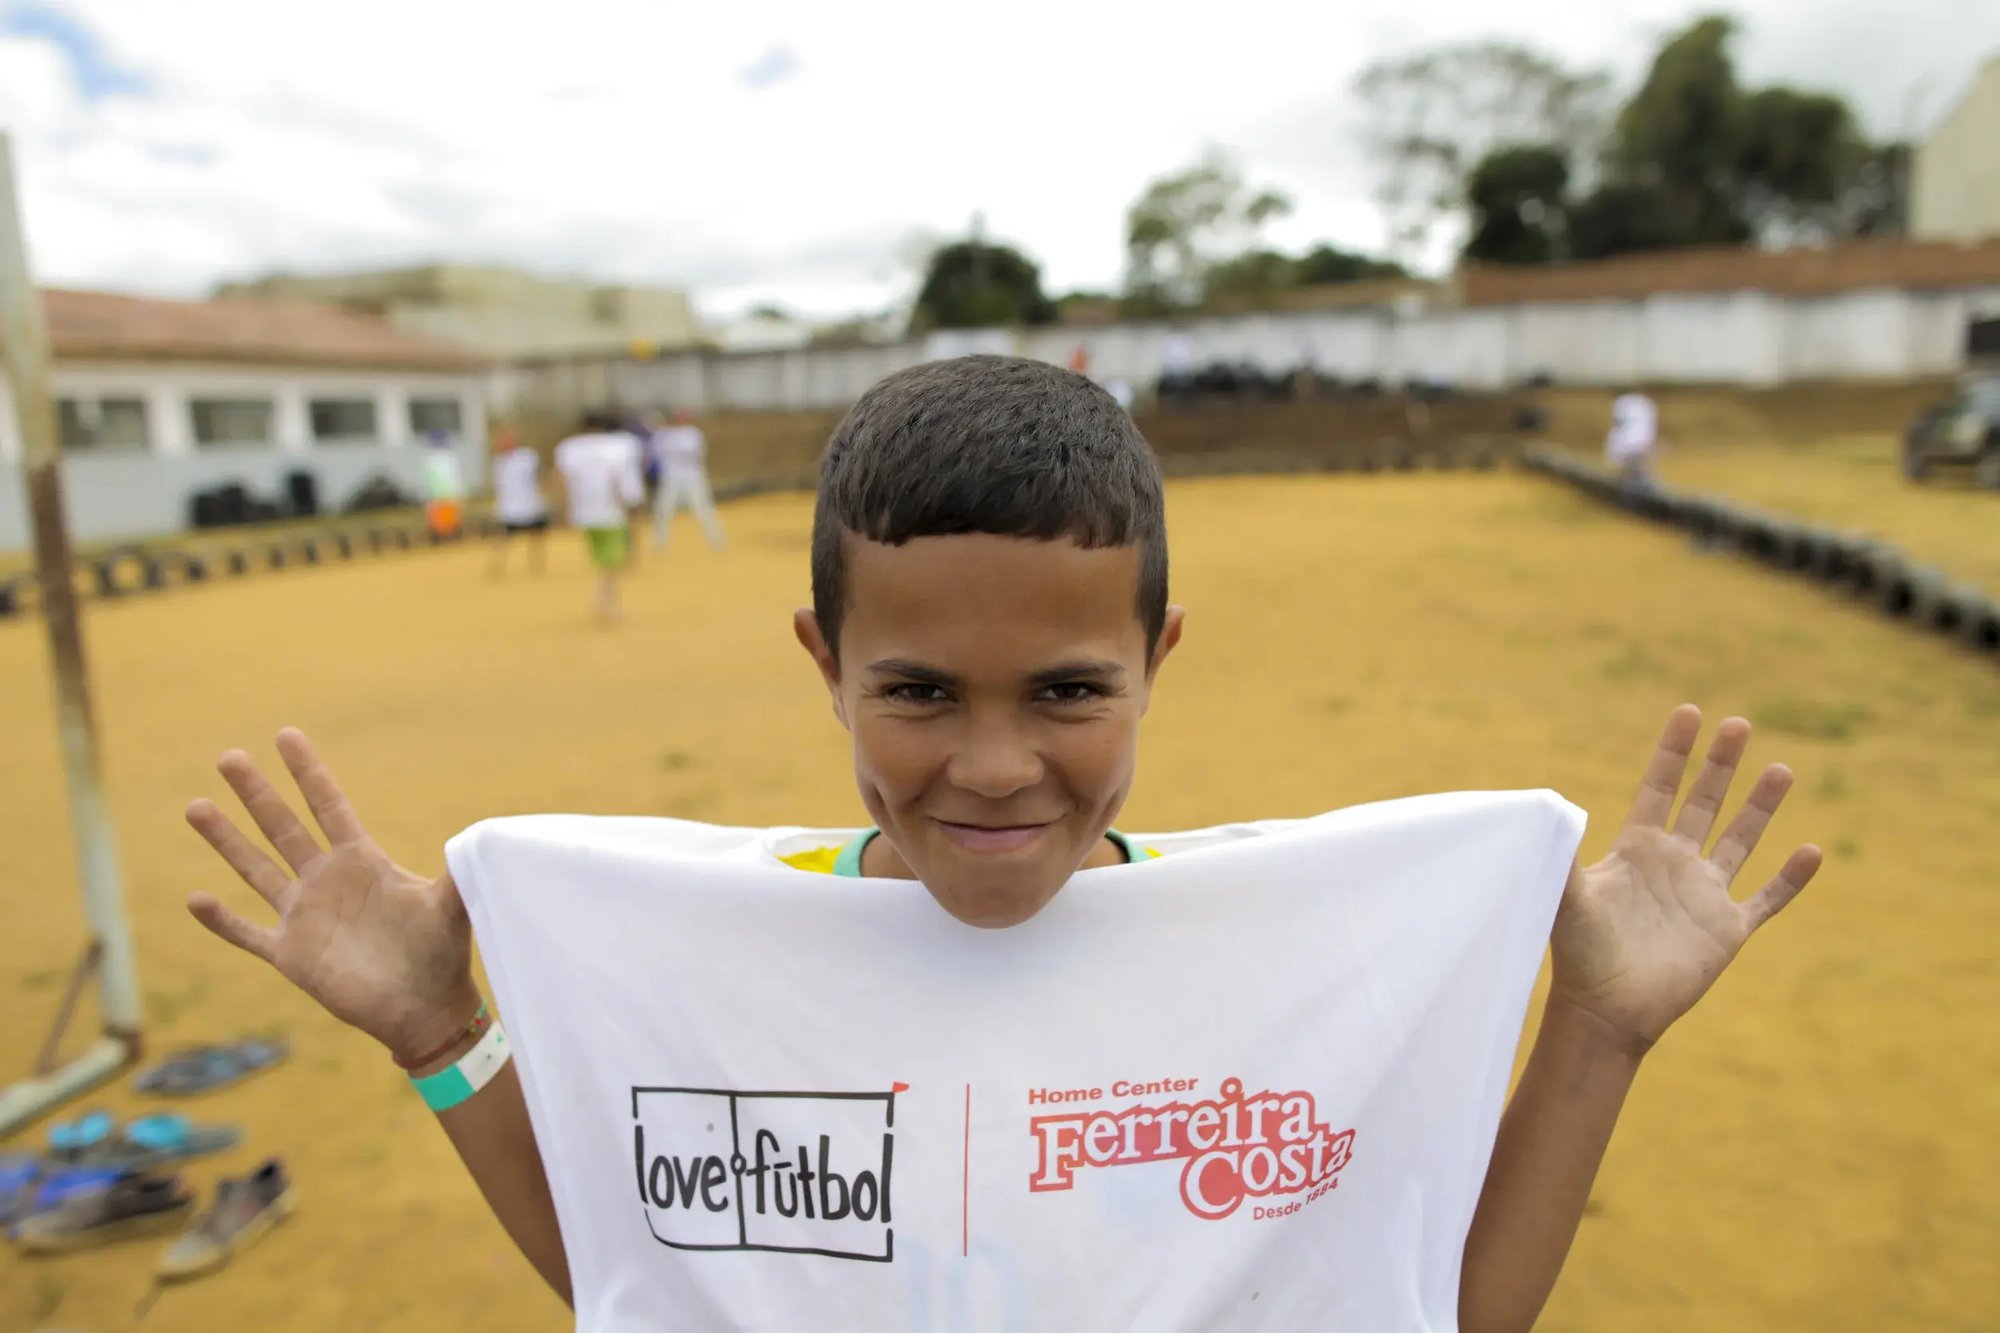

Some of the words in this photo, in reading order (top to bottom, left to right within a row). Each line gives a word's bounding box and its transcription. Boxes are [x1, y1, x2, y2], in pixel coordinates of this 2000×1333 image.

[1028, 1086, 1103, 1105] Home
[1111, 1077, 1199, 1098] Center
[1030, 1077, 1316, 1192] Ferreira
[634, 1124, 729, 1213] love
[1181, 1129, 1356, 1220] Costa
[1253, 1201, 1303, 1221] Desde
[1305, 1177, 1339, 1207] 1884
